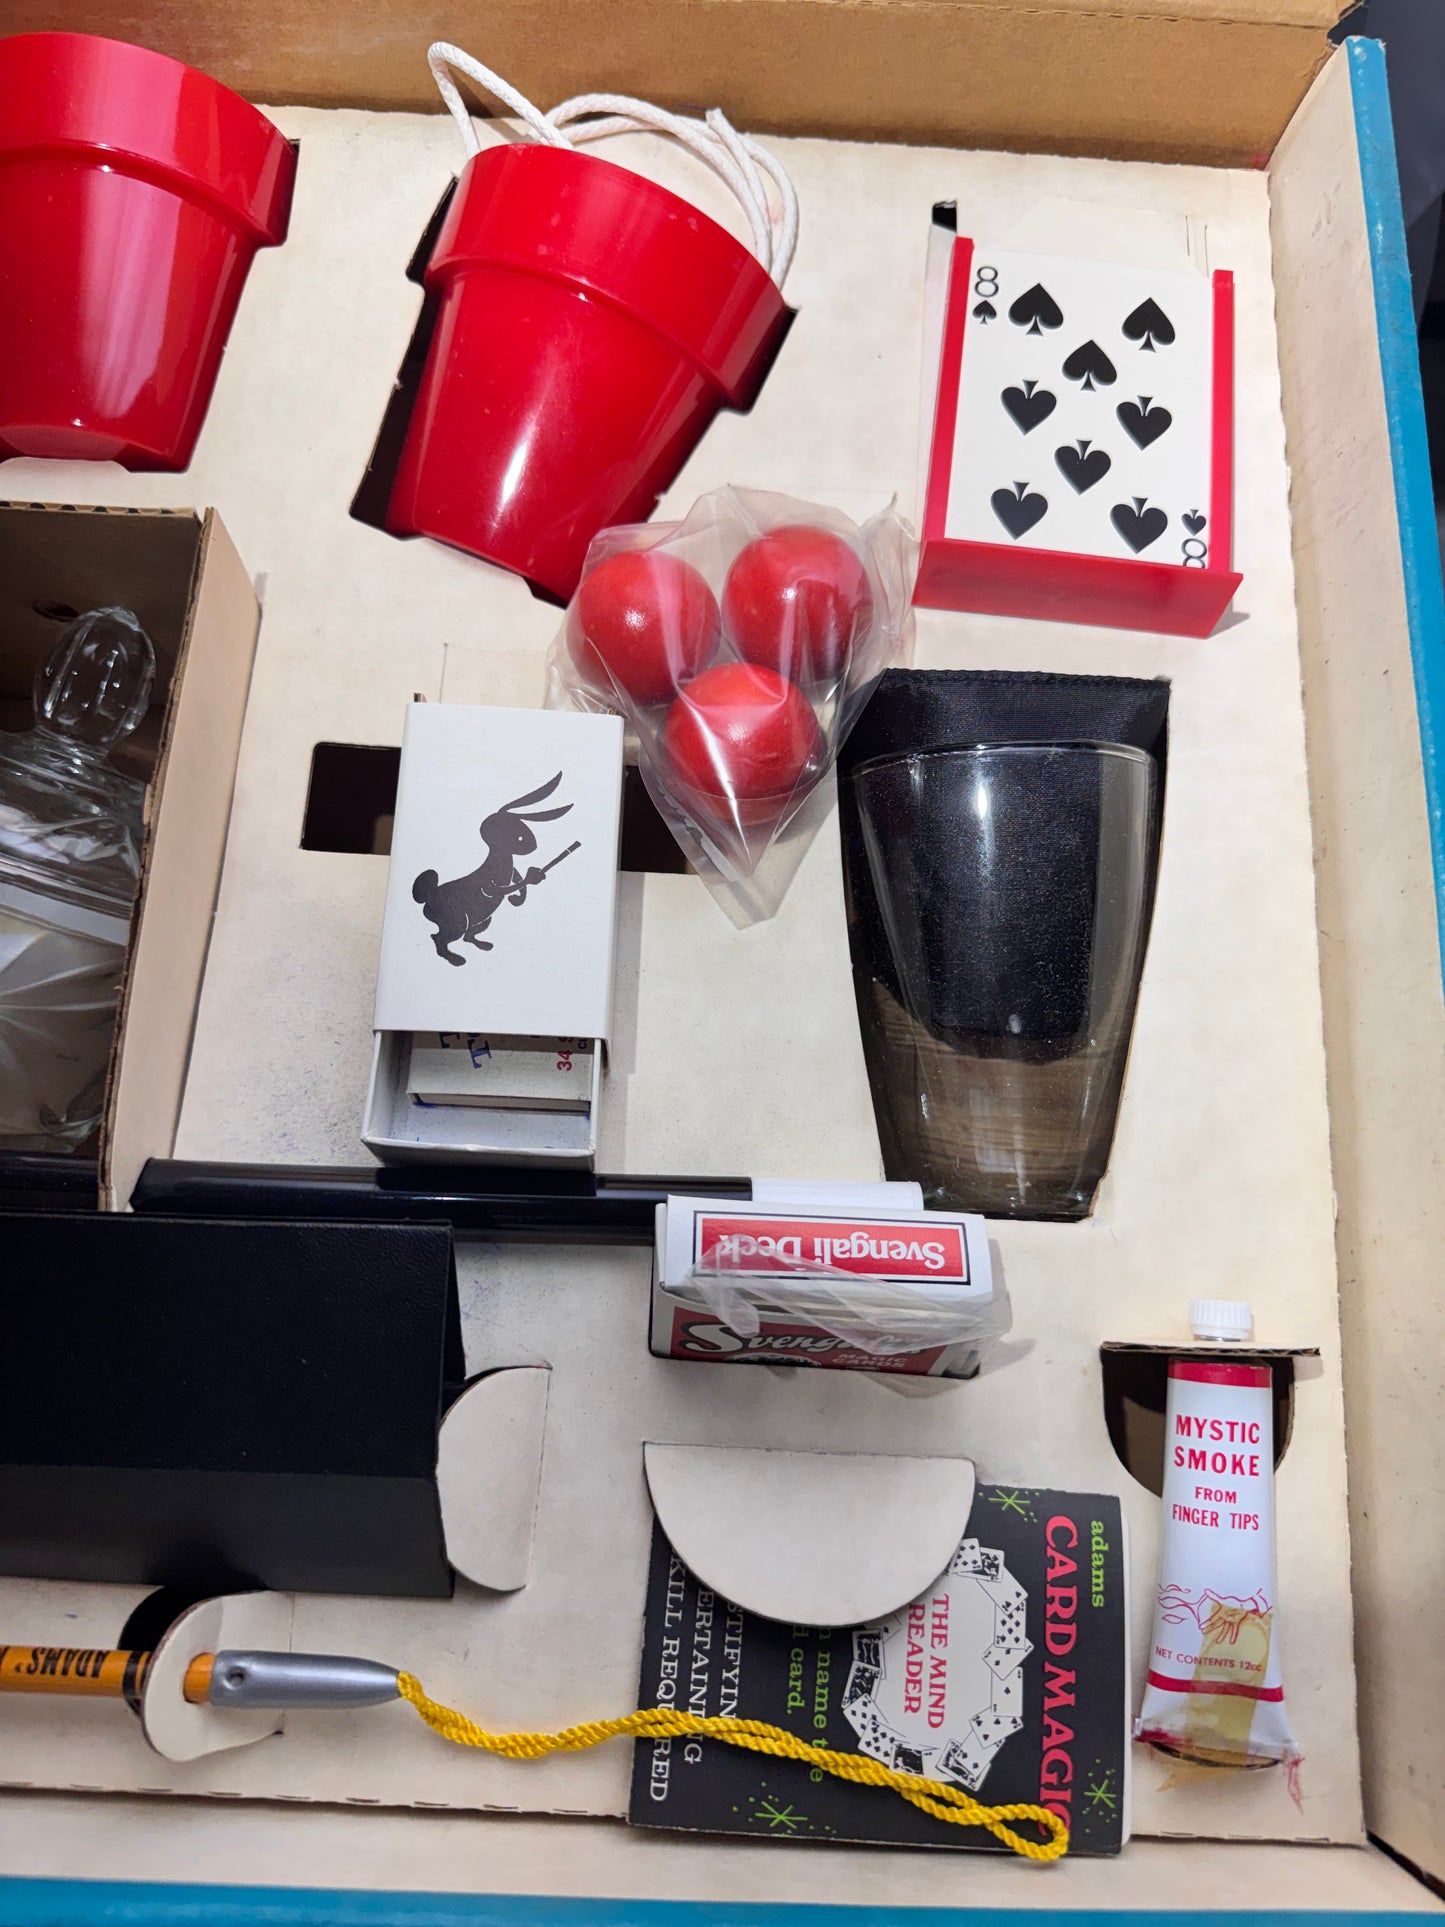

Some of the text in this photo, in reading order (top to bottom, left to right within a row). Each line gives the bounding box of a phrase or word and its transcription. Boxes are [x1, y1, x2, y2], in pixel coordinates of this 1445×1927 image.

[973, 265, 1000, 298] 8
[556, 1049, 574, 1072] 34
[718, 1231, 946, 1270] Svengali Deck
[838, 1353, 908, 1363] MAGIC
[1174, 1413, 1262, 1445] MYSTIC
[1173, 1445, 1261, 1477] SMOKE
[1194, 1485, 1238, 1505] FROM
[1171, 1503, 1260, 1531] FINGER TIPS
[1090, 1520, 1110, 1609] adams
[903, 1602, 926, 1714] READER
[926, 1592, 950, 1730] THE MIND
[1039, 1515, 1079, 1838] CARD MAGIC
[1154, 1645, 1174, 1660] NET
[1175, 1652, 1236, 1671] CONTENTS
[786, 1647, 806, 1715] card.
[812, 1650, 832, 1729] name
[650, 1635, 681, 1801] REQRED
[810, 1736, 829, 1783] te
